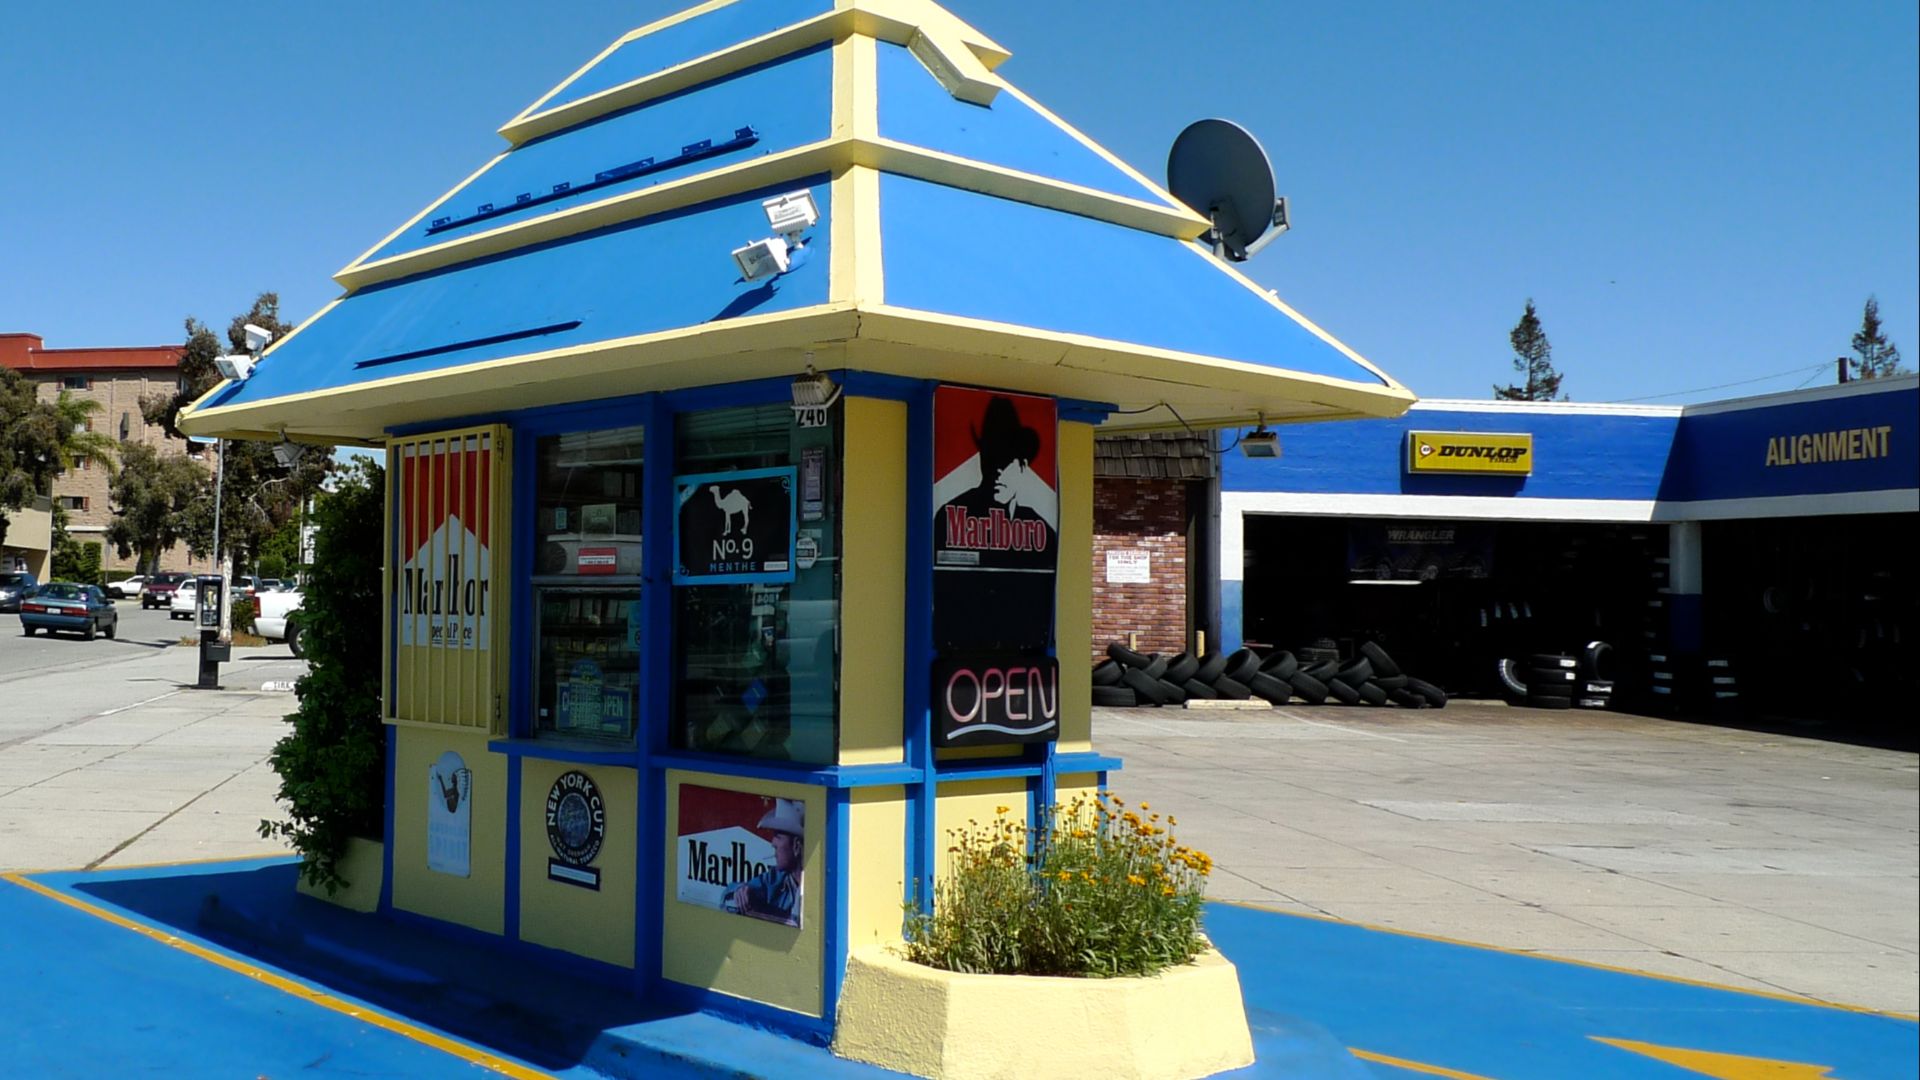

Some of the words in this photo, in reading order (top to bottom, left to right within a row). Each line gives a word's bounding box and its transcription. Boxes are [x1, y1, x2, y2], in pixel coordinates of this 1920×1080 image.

[1438, 445, 1527, 459] DUNLOP
[1765, 426, 1891, 466] ALIGNMENT
[946, 505, 1046, 552] Marlboro
[1387, 529, 1455, 540] WRANGLER
[709, 561, 756, 572] MENTHE
[946, 667, 1057, 722] OPEN
[547, 785, 561, 826] NEW
[560, 774, 593, 797] YORK
[591, 796, 603, 837] CUT
[688, 839, 776, 887] Marlbo
